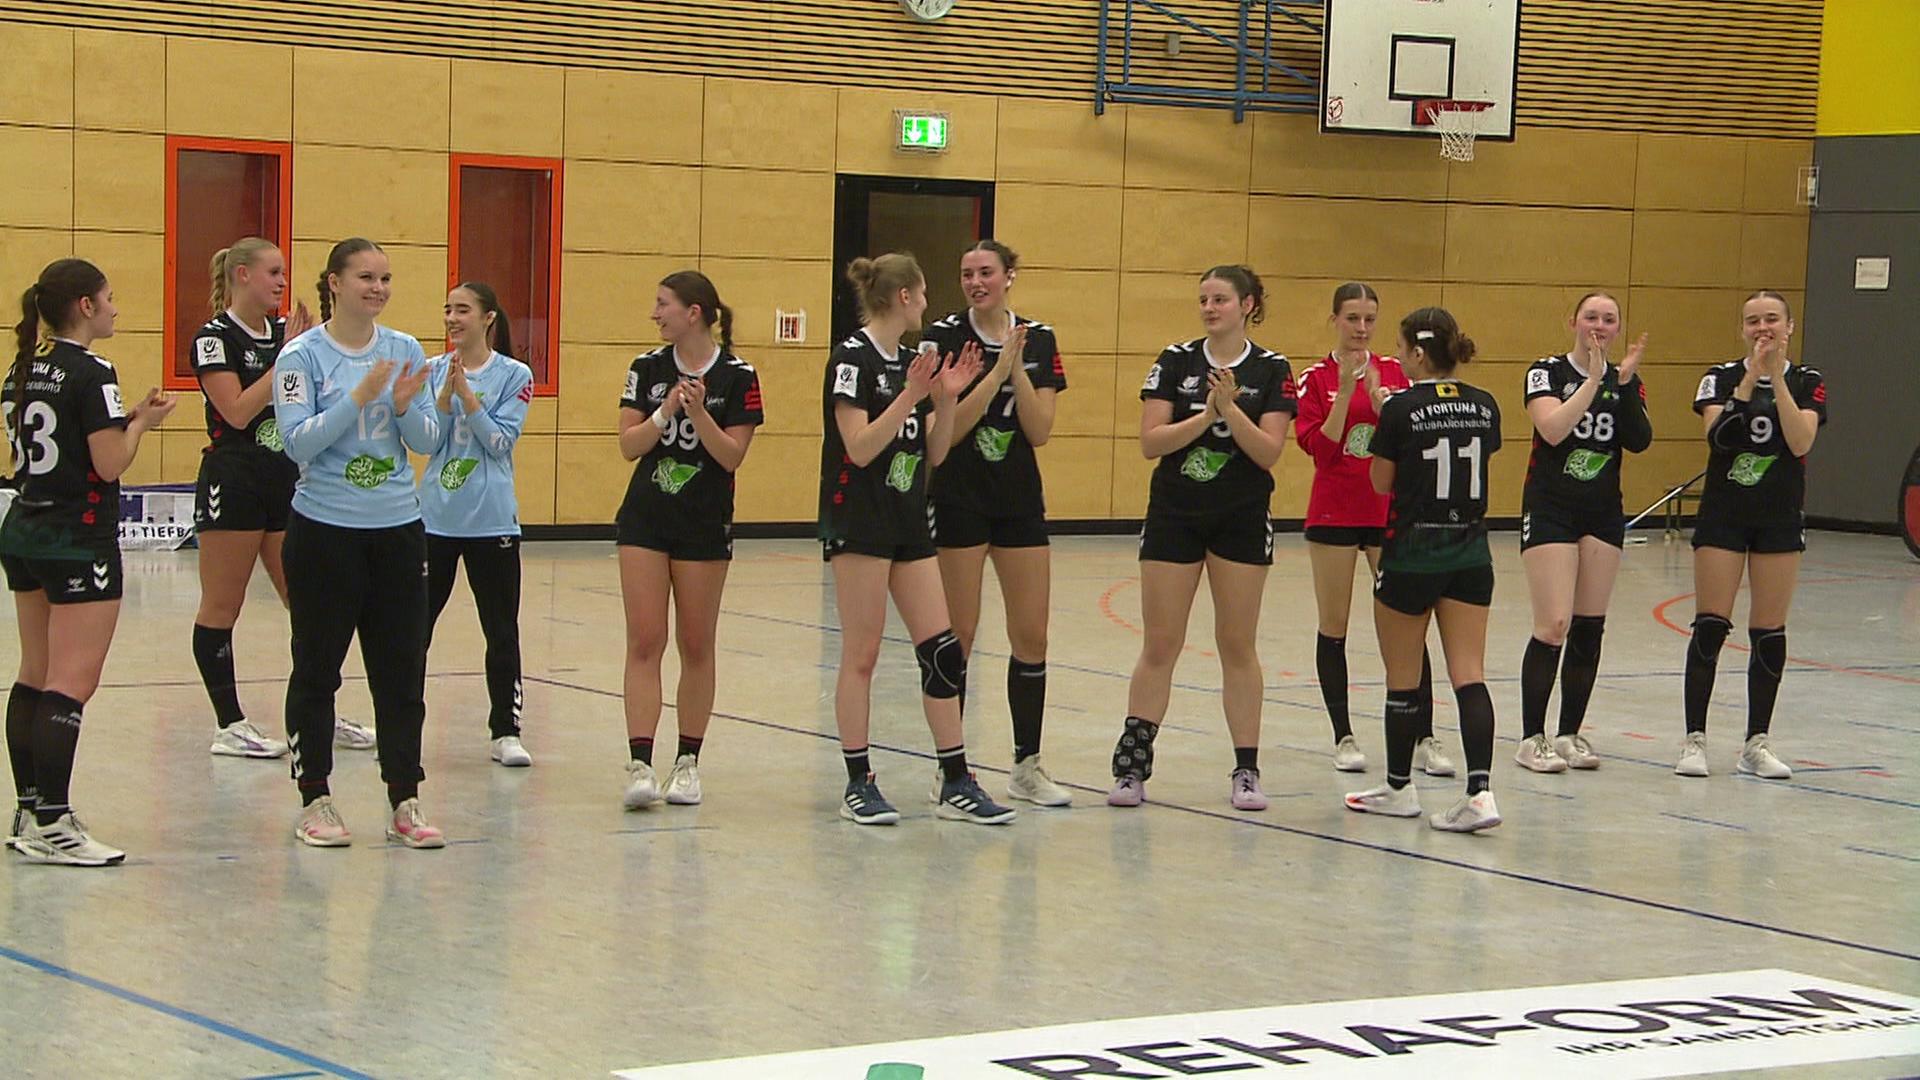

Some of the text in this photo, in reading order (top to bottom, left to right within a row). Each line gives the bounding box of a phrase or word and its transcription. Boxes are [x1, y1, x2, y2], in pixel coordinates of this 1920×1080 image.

[358, 403, 392, 441] 12
[1426, 402, 1477, 417] FORTUNA
[1573, 411, 1615, 442] 38
[661, 415, 700, 450] 99
[1749, 415, 1774, 444] 9
[1422, 437, 1481, 499] 11
[989, 988, 1912, 1080] REHAFORM
